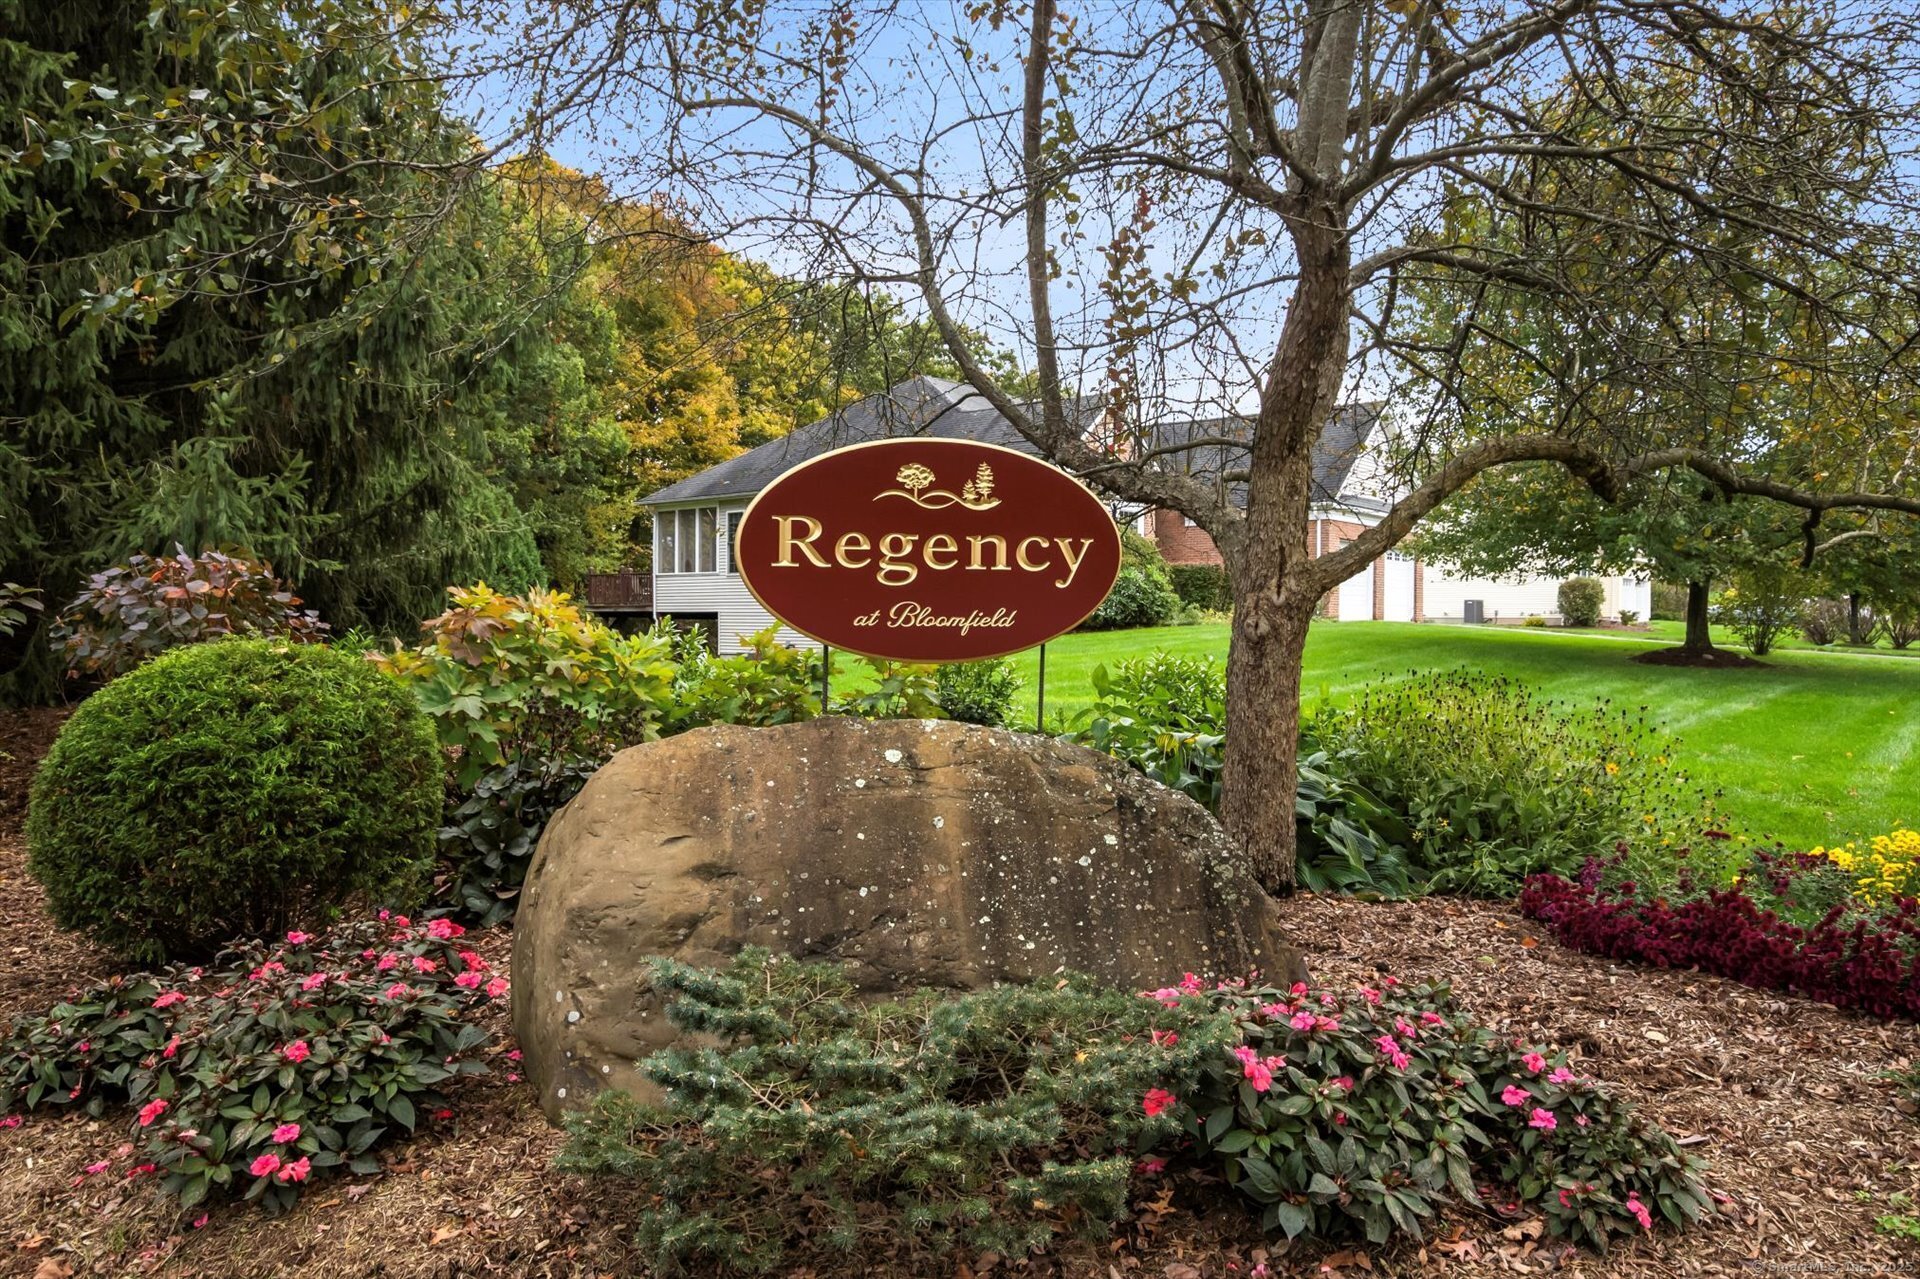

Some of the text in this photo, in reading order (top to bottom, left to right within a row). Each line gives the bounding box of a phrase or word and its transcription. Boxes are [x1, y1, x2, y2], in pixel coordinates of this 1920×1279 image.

[771, 515, 1094, 588] Regency
[853, 601, 1017, 636] at Bloomfield
